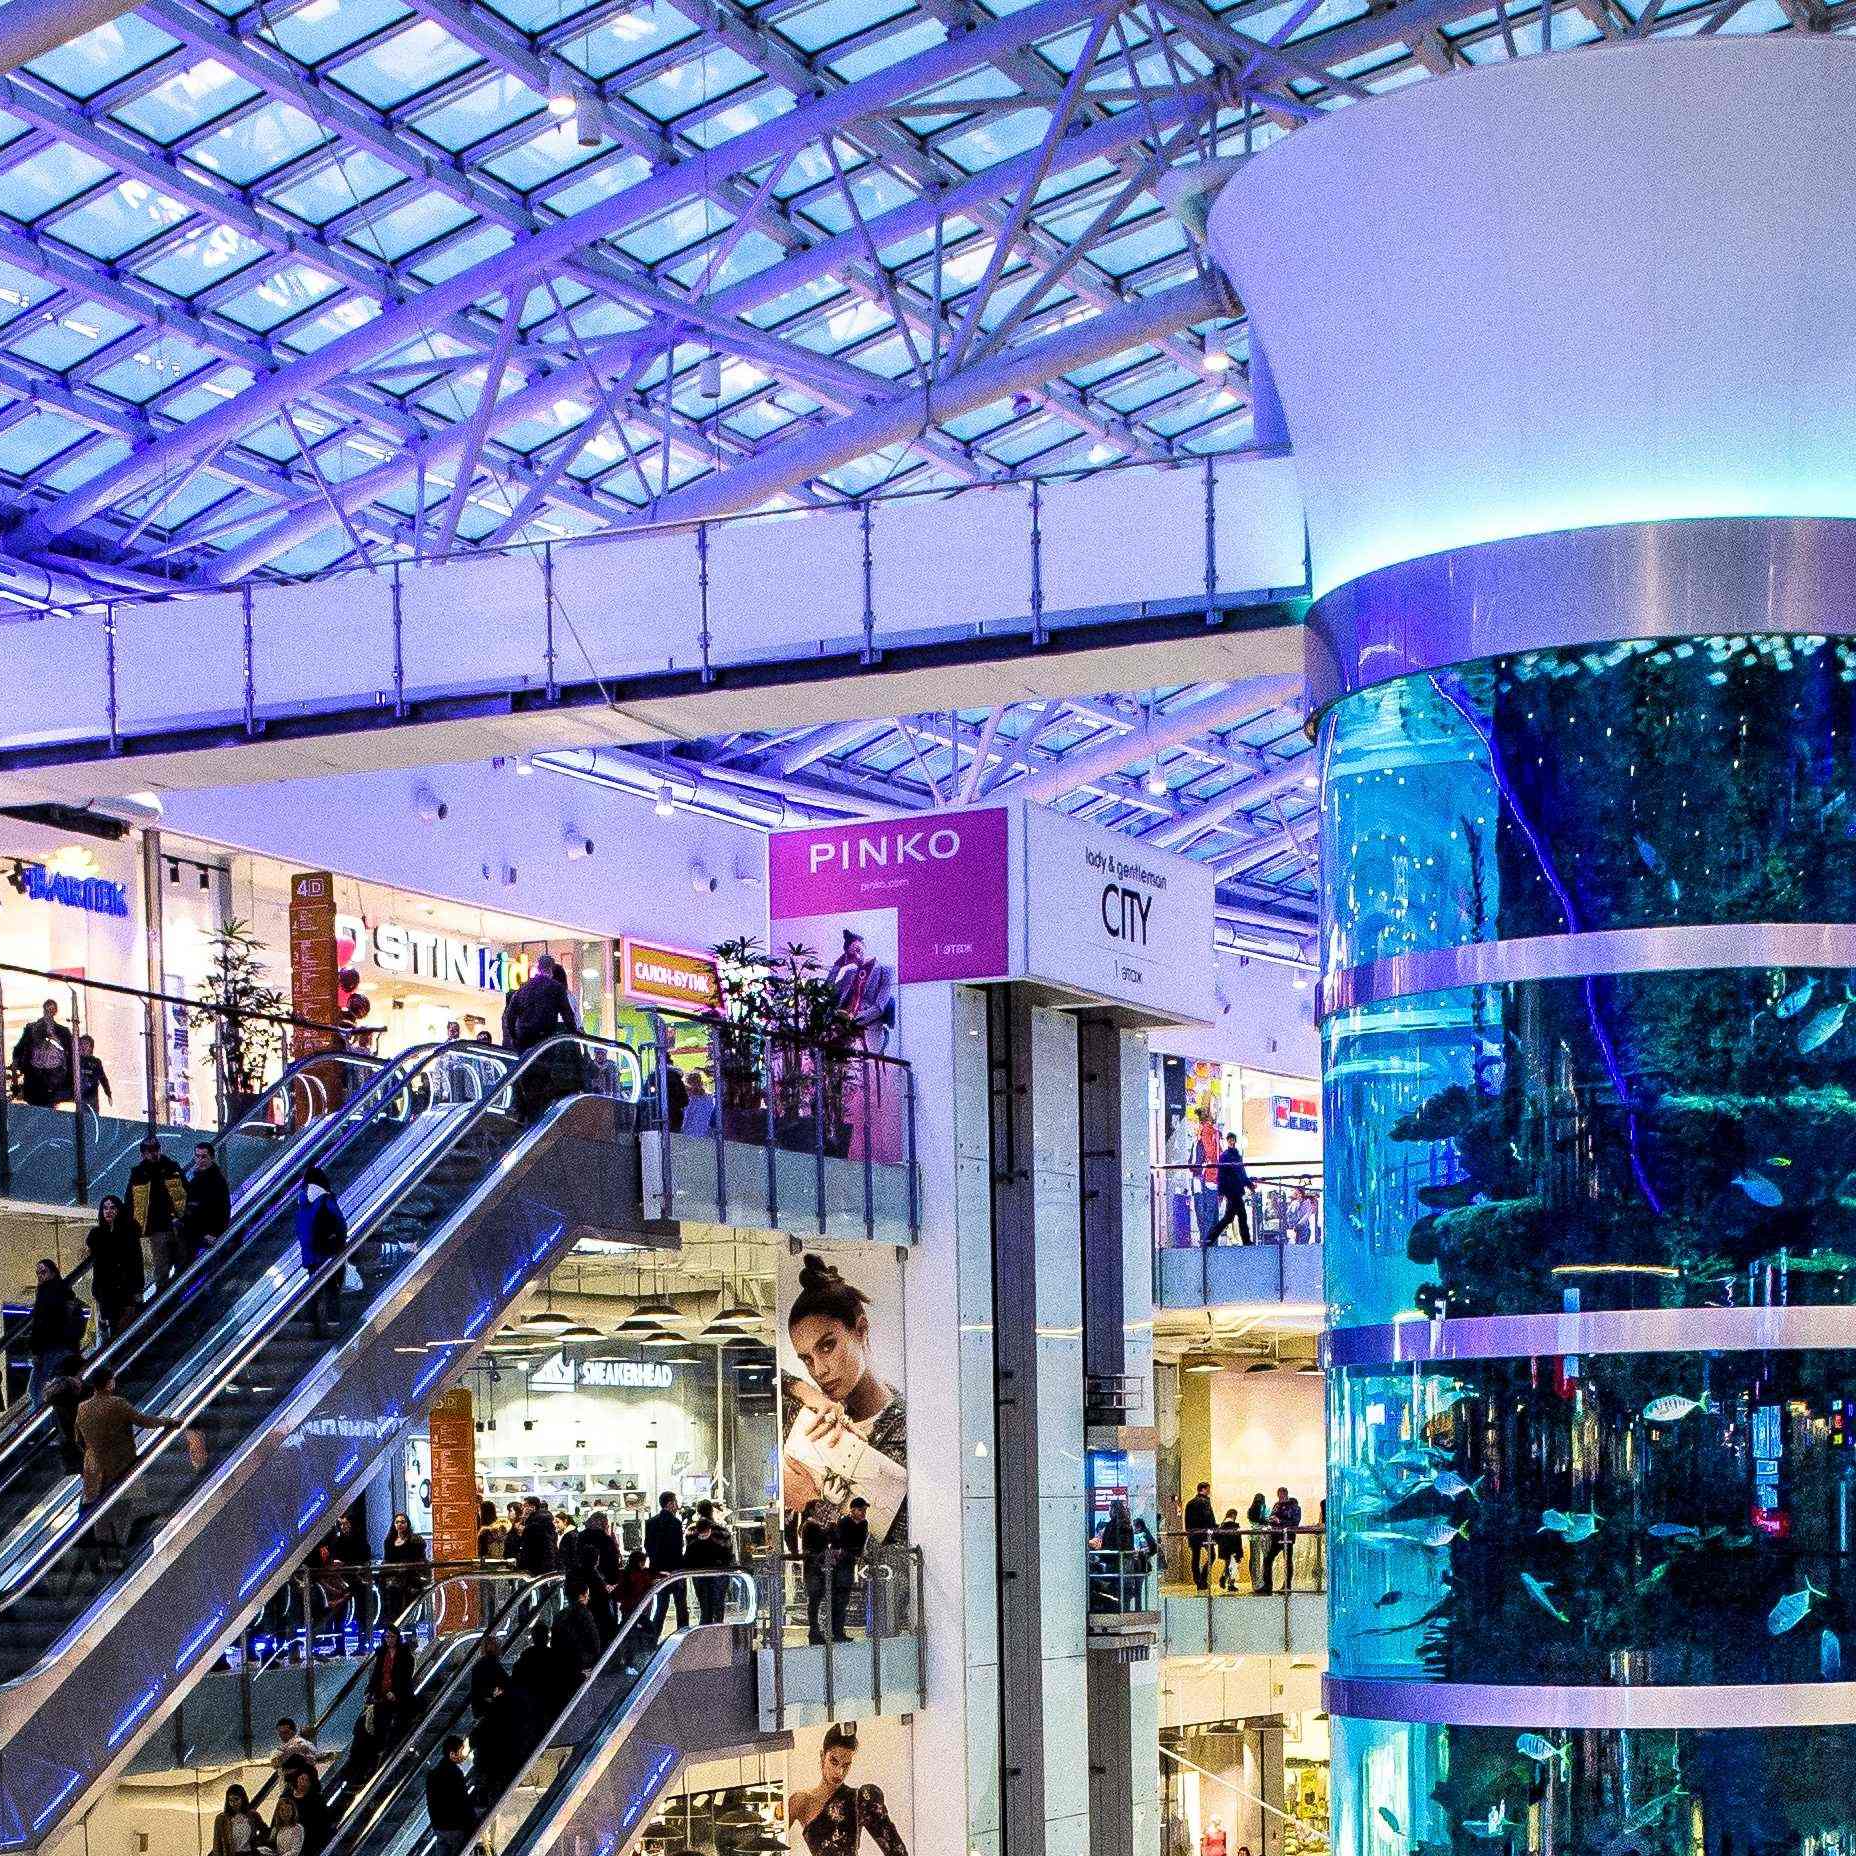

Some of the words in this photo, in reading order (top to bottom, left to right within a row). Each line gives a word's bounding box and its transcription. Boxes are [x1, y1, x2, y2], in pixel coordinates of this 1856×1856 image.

[808, 829, 961, 874] PINKO
[1101, 883, 1153, 946] CITY
[634, 961, 711, 993] САЛОН-БУТИК
[582, 1360, 674, 1388] SNEAKERHEAD
